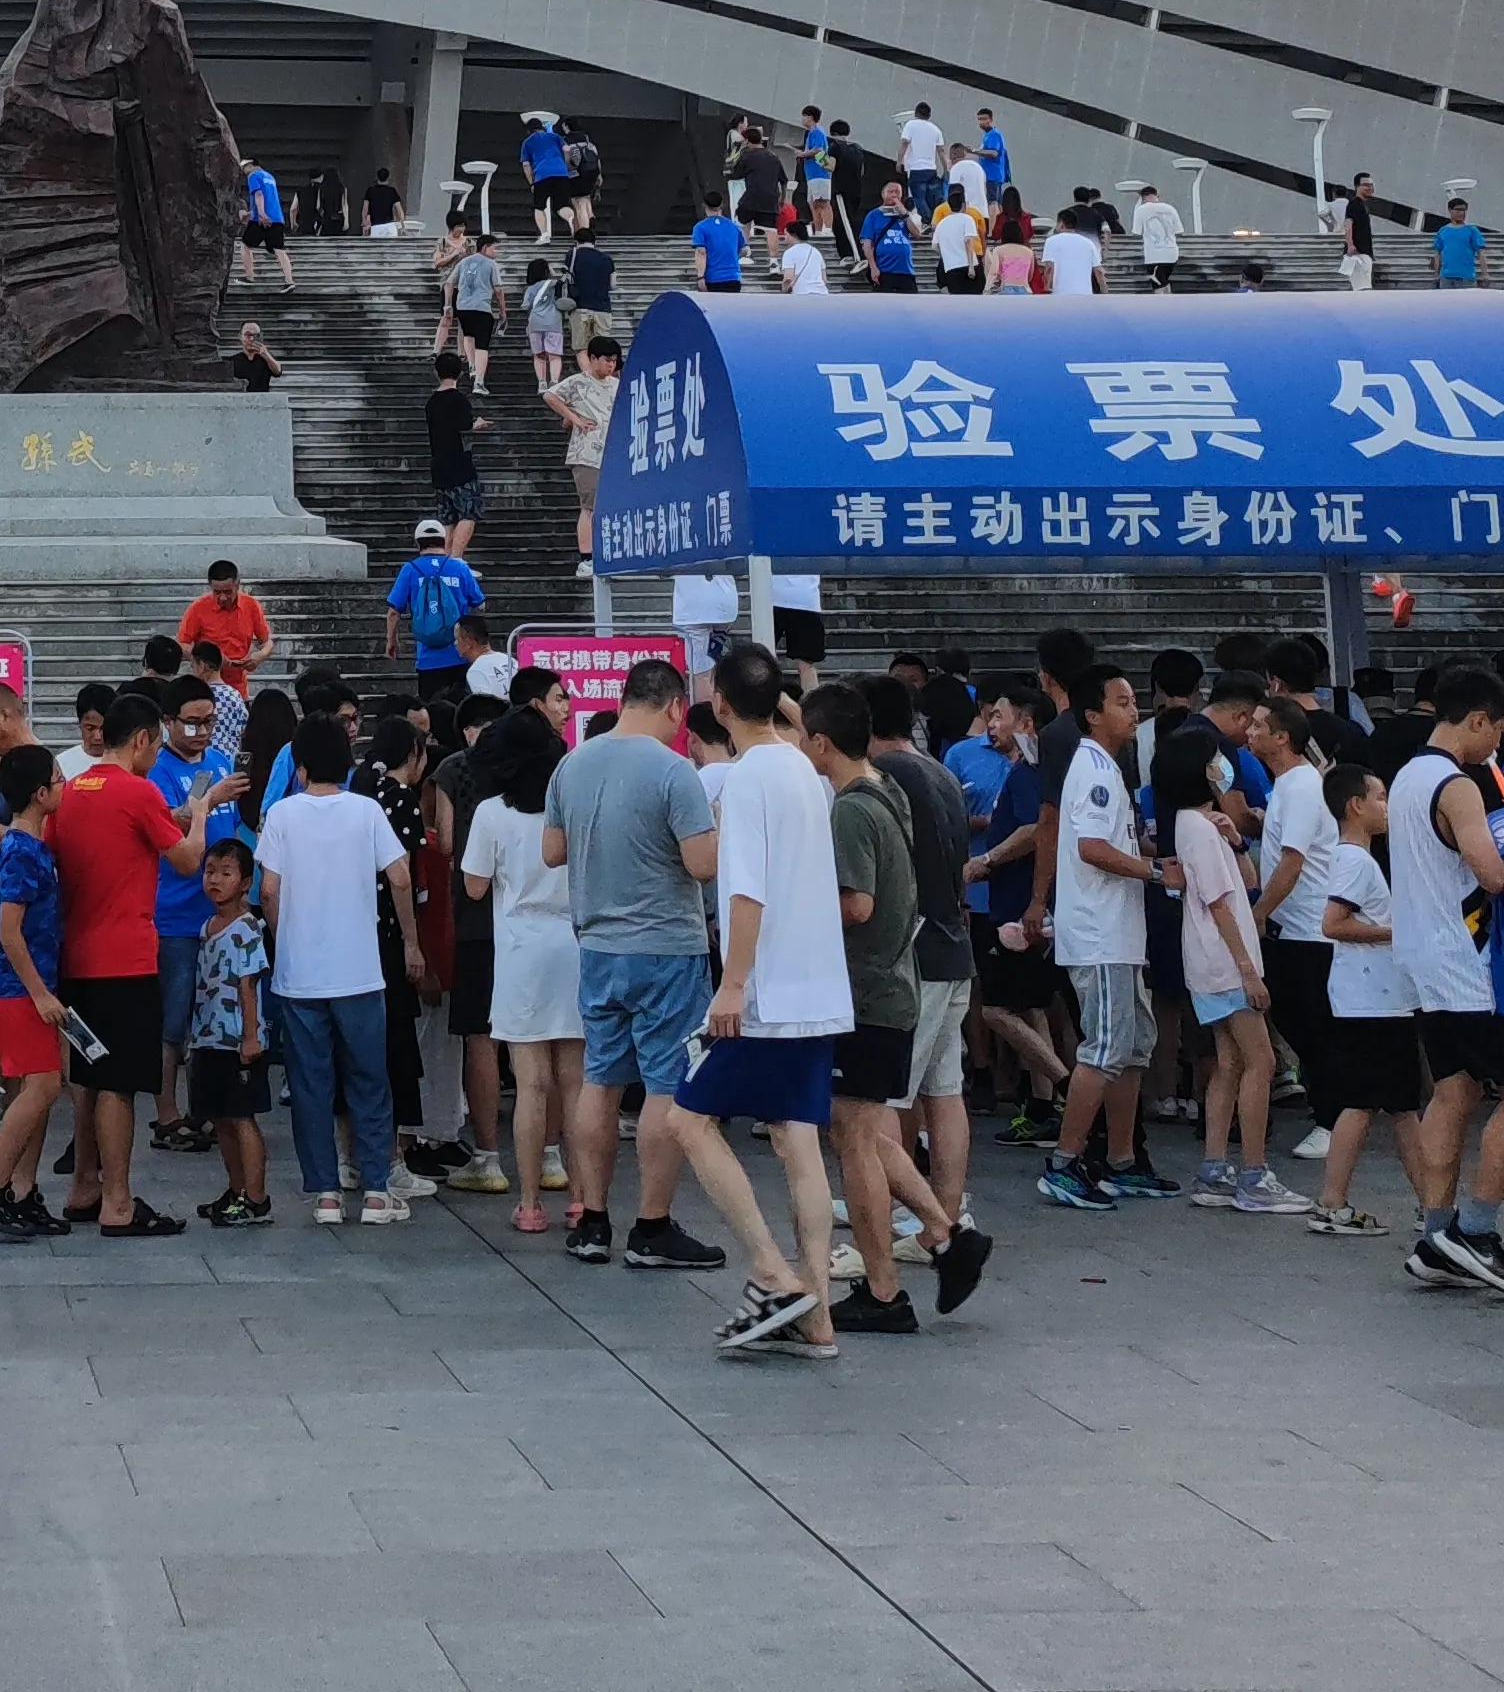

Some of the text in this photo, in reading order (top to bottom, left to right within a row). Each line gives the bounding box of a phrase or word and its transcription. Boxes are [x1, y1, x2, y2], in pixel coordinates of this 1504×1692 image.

[627, 351, 706, 476] 验票处
[601, 490, 733, 563] 请主动出示身份证、门票
[566, 678, 627, 699] 入场流
